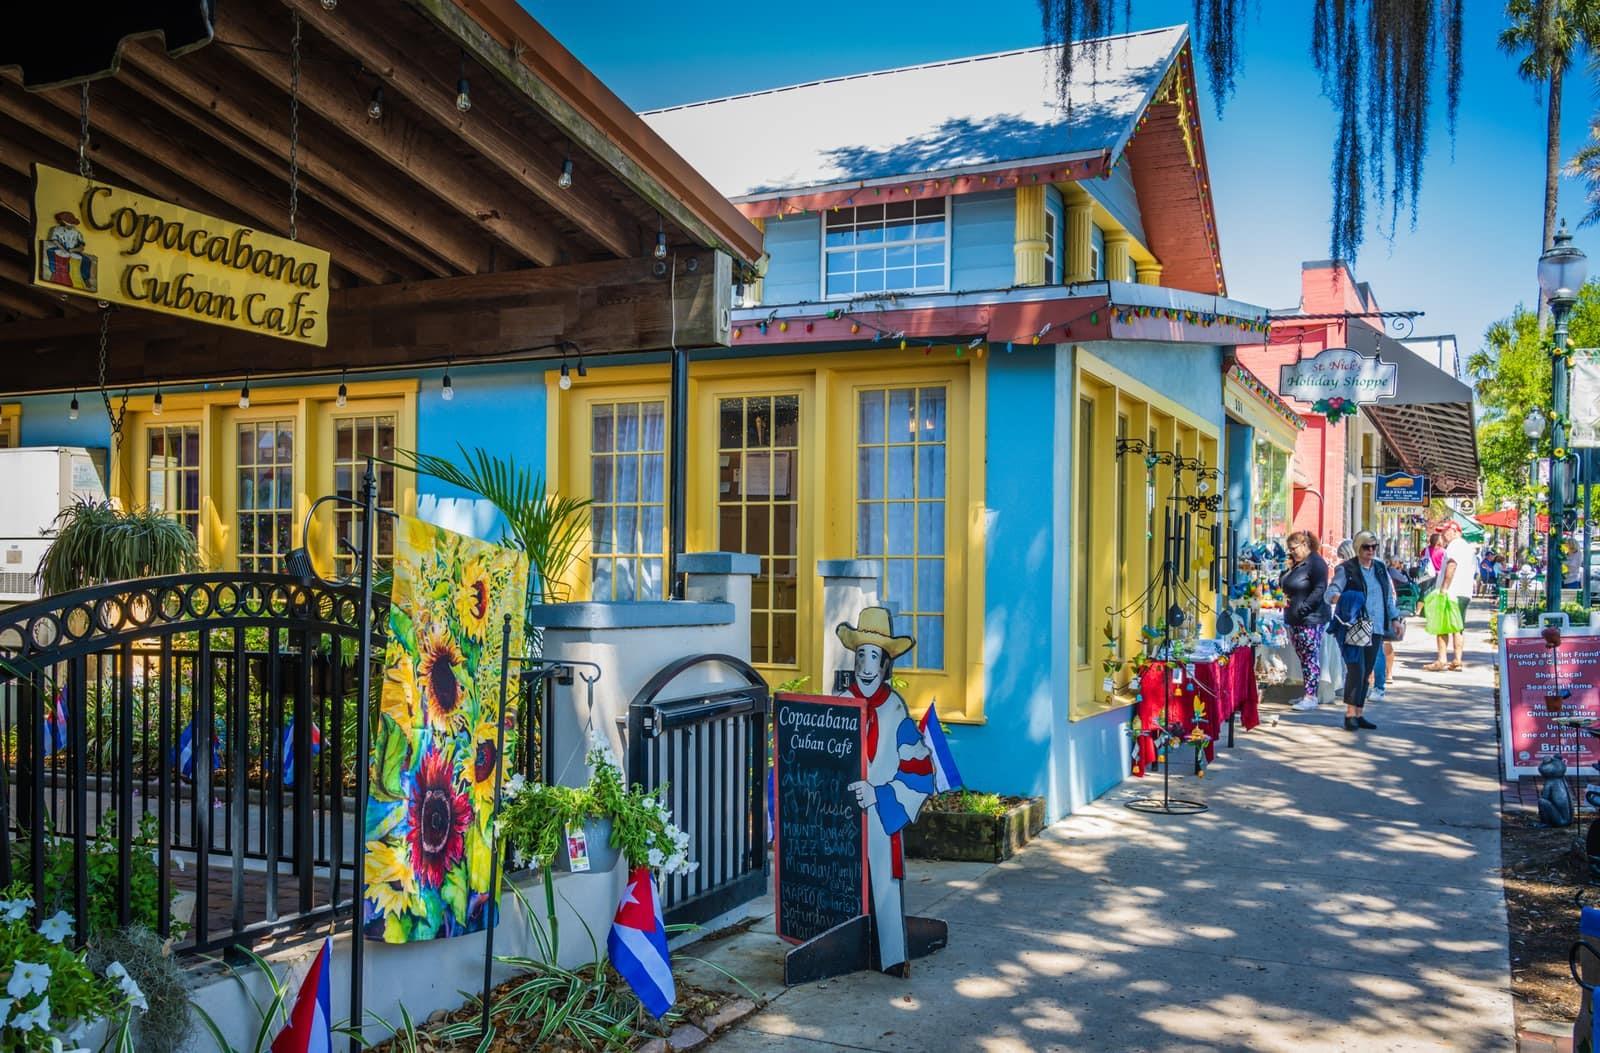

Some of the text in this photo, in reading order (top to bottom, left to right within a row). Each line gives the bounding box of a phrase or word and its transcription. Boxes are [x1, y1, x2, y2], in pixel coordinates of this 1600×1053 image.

[79, 186, 321, 290] Copacabana
[119, 263, 317, 339] Cuban Café
[1329, 359, 1362, 372] Nick's
[1287, 374, 1389, 392] Holiday Shoppe
[779, 706, 859, 732] Copacabana
[790, 734, 824, 752] Cuban
[803, 788, 855, 819] Music
[786, 838, 818, 857] JAZZ
